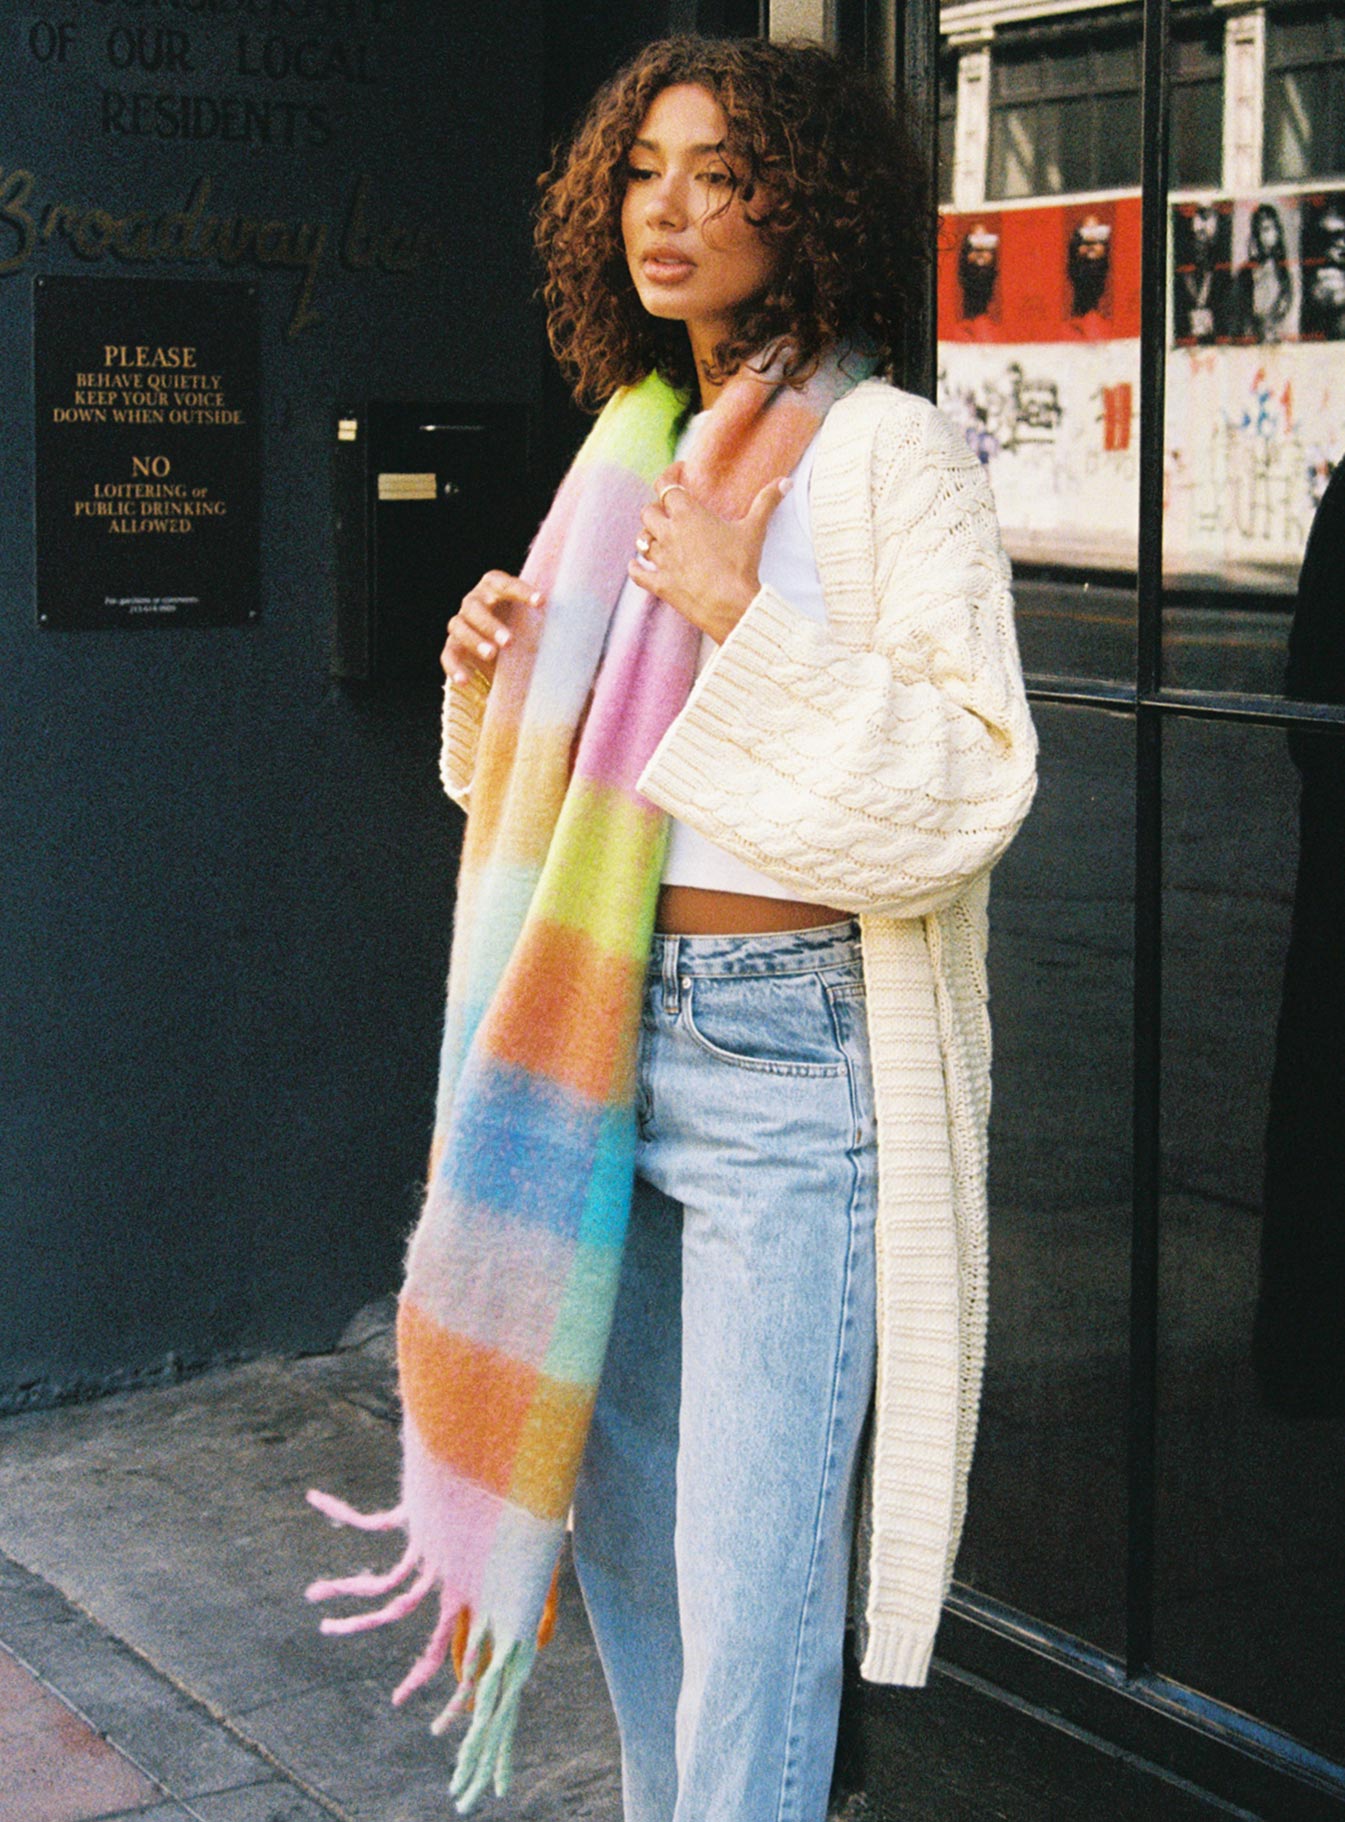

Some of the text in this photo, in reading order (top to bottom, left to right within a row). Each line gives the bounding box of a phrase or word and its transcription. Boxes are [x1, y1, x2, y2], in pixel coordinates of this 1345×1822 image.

[28, 20, 378, 85] OF OUR LOCAL
[101, 90, 333, 147] RESIDENTS
[104, 345, 197, 368] PLEASE
[76, 373, 144, 389] BEHAVE
[74, 391, 225, 407] KEEP YOUR VOICE
[53, 408, 107, 423] DOWN
[112, 409, 165, 424] WHEN
[131, 456, 171, 477] NO
[94, 484, 188, 498] LOITERING
[74, 501, 227, 516] PUBLIC DRINKING
